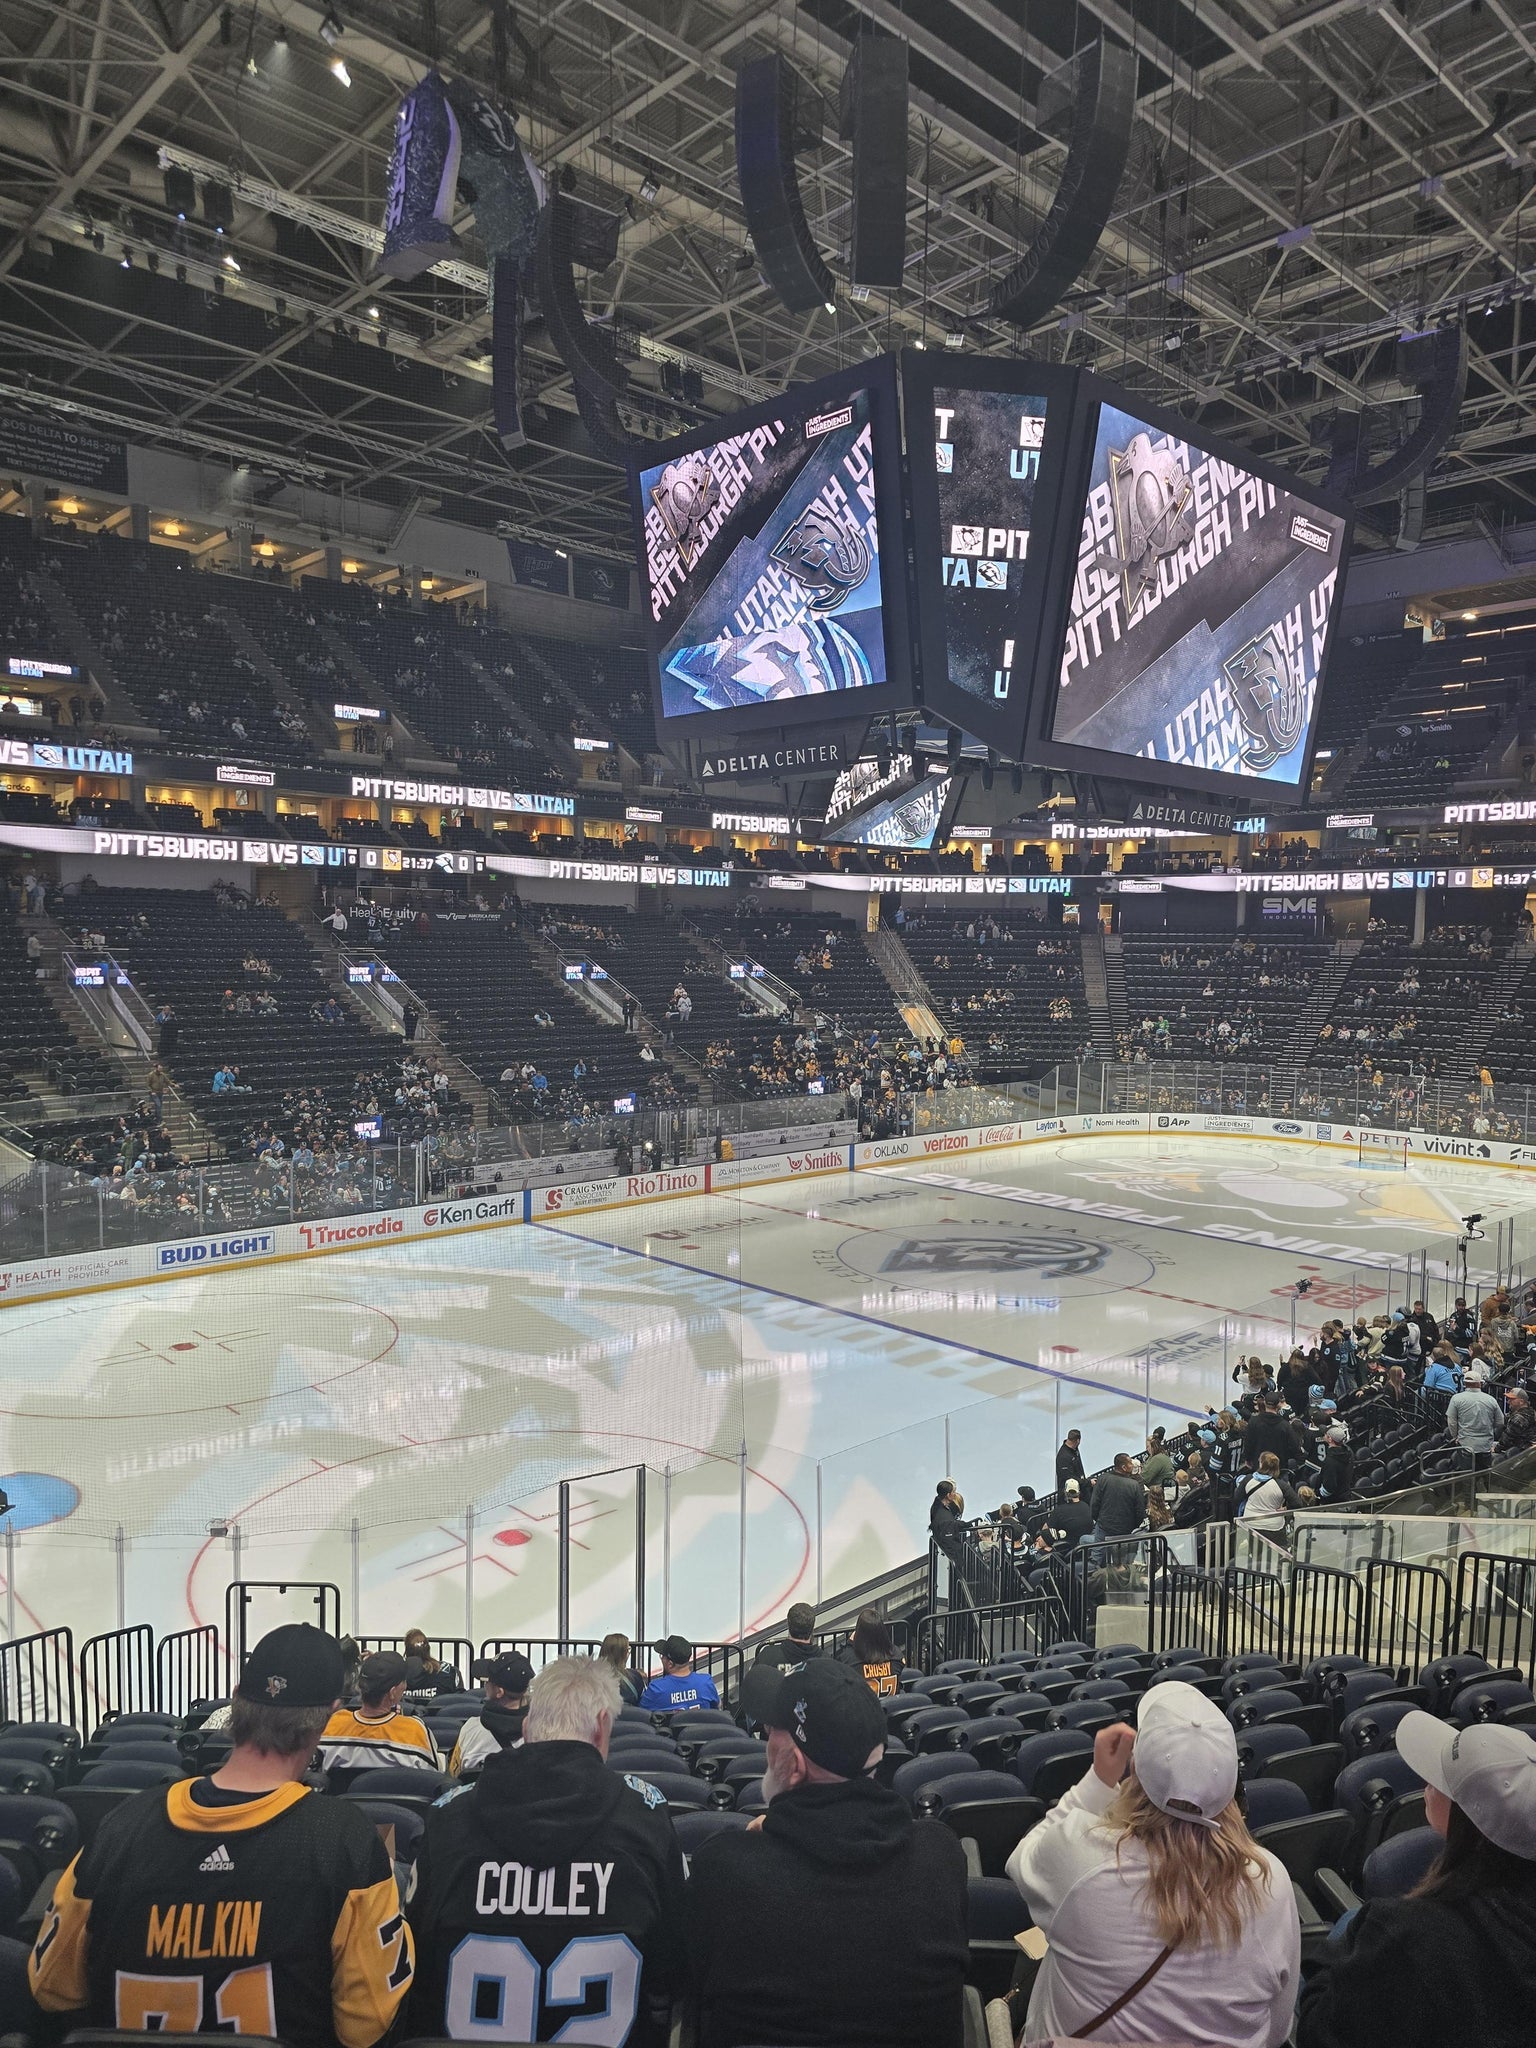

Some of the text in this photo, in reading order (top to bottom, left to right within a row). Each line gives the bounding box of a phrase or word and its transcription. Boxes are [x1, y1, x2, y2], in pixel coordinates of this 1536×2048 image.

[808, 415, 822, 426] JUST
[808, 413, 849, 434] INGREDIENTS
[63, 432, 78, 443] TO
[67, 748, 133, 775] UTAH
[717, 744, 840, 775] DELTA CENTER
[220, 772, 271, 783] INGREDIENTS
[352, 777, 574, 816] PITTSBURGH VS UTAH
[1146, 805, 1232, 829] DELTA CENTER
[95, 832, 298, 864] PITTSBURGH VS
[366, 852, 377, 866] 0
[402, 857, 434, 869] 21:37
[458, 857, 469, 870] 0
[550, 860, 729, 887] PITTSBURGH VS UTAH
[1455, 872, 1466, 885] 0
[1493, 873, 1530, 885] 21:37
[869, 877, 1070, 893] PITTSBURGH VS UTAH
[1236, 873, 1339, 892] PITTSBURGH
[1365, 872, 1390, 889] VS
[1262, 897, 1317, 914] SME
[1036, 1120, 1058, 1132] Layton
[1116, 1118, 1140, 1126] Health
[1207, 1120, 1251, 1128] INGREDIENTS
[1278, 1123, 1298, 1133] Ford
[874, 1143, 909, 1158] OKLAND
[923, 1134, 968, 1153] verizon
[1424, 1137, 1475, 1157] vivint
[805, 1151, 843, 1170] Smith's
[564, 1181, 617, 1196] CRAIG SWAPP
[627, 1172, 698, 1198] Rio Tinto
[441, 1199, 516, 1225] Ken Garff
[316, 1217, 404, 1244] Trucordia
[971, 1218, 1080, 1235] DELTA
[161, 1236, 271, 1266] BUD LIGHT
[68, 1258, 129, 1274] OFFICIAL CARE
[15, 1268, 61, 1283] HEALTH
[68, 1269, 110, 1281] PROVIDER
[1317, 1443, 1327, 1462] 9
[863, 1661, 893, 1678] CROSBY
[670, 1689, 698, 1704] KELLER
[199, 1860, 235, 1872] adidas
[146, 1900, 262, 1959] MALKIN
